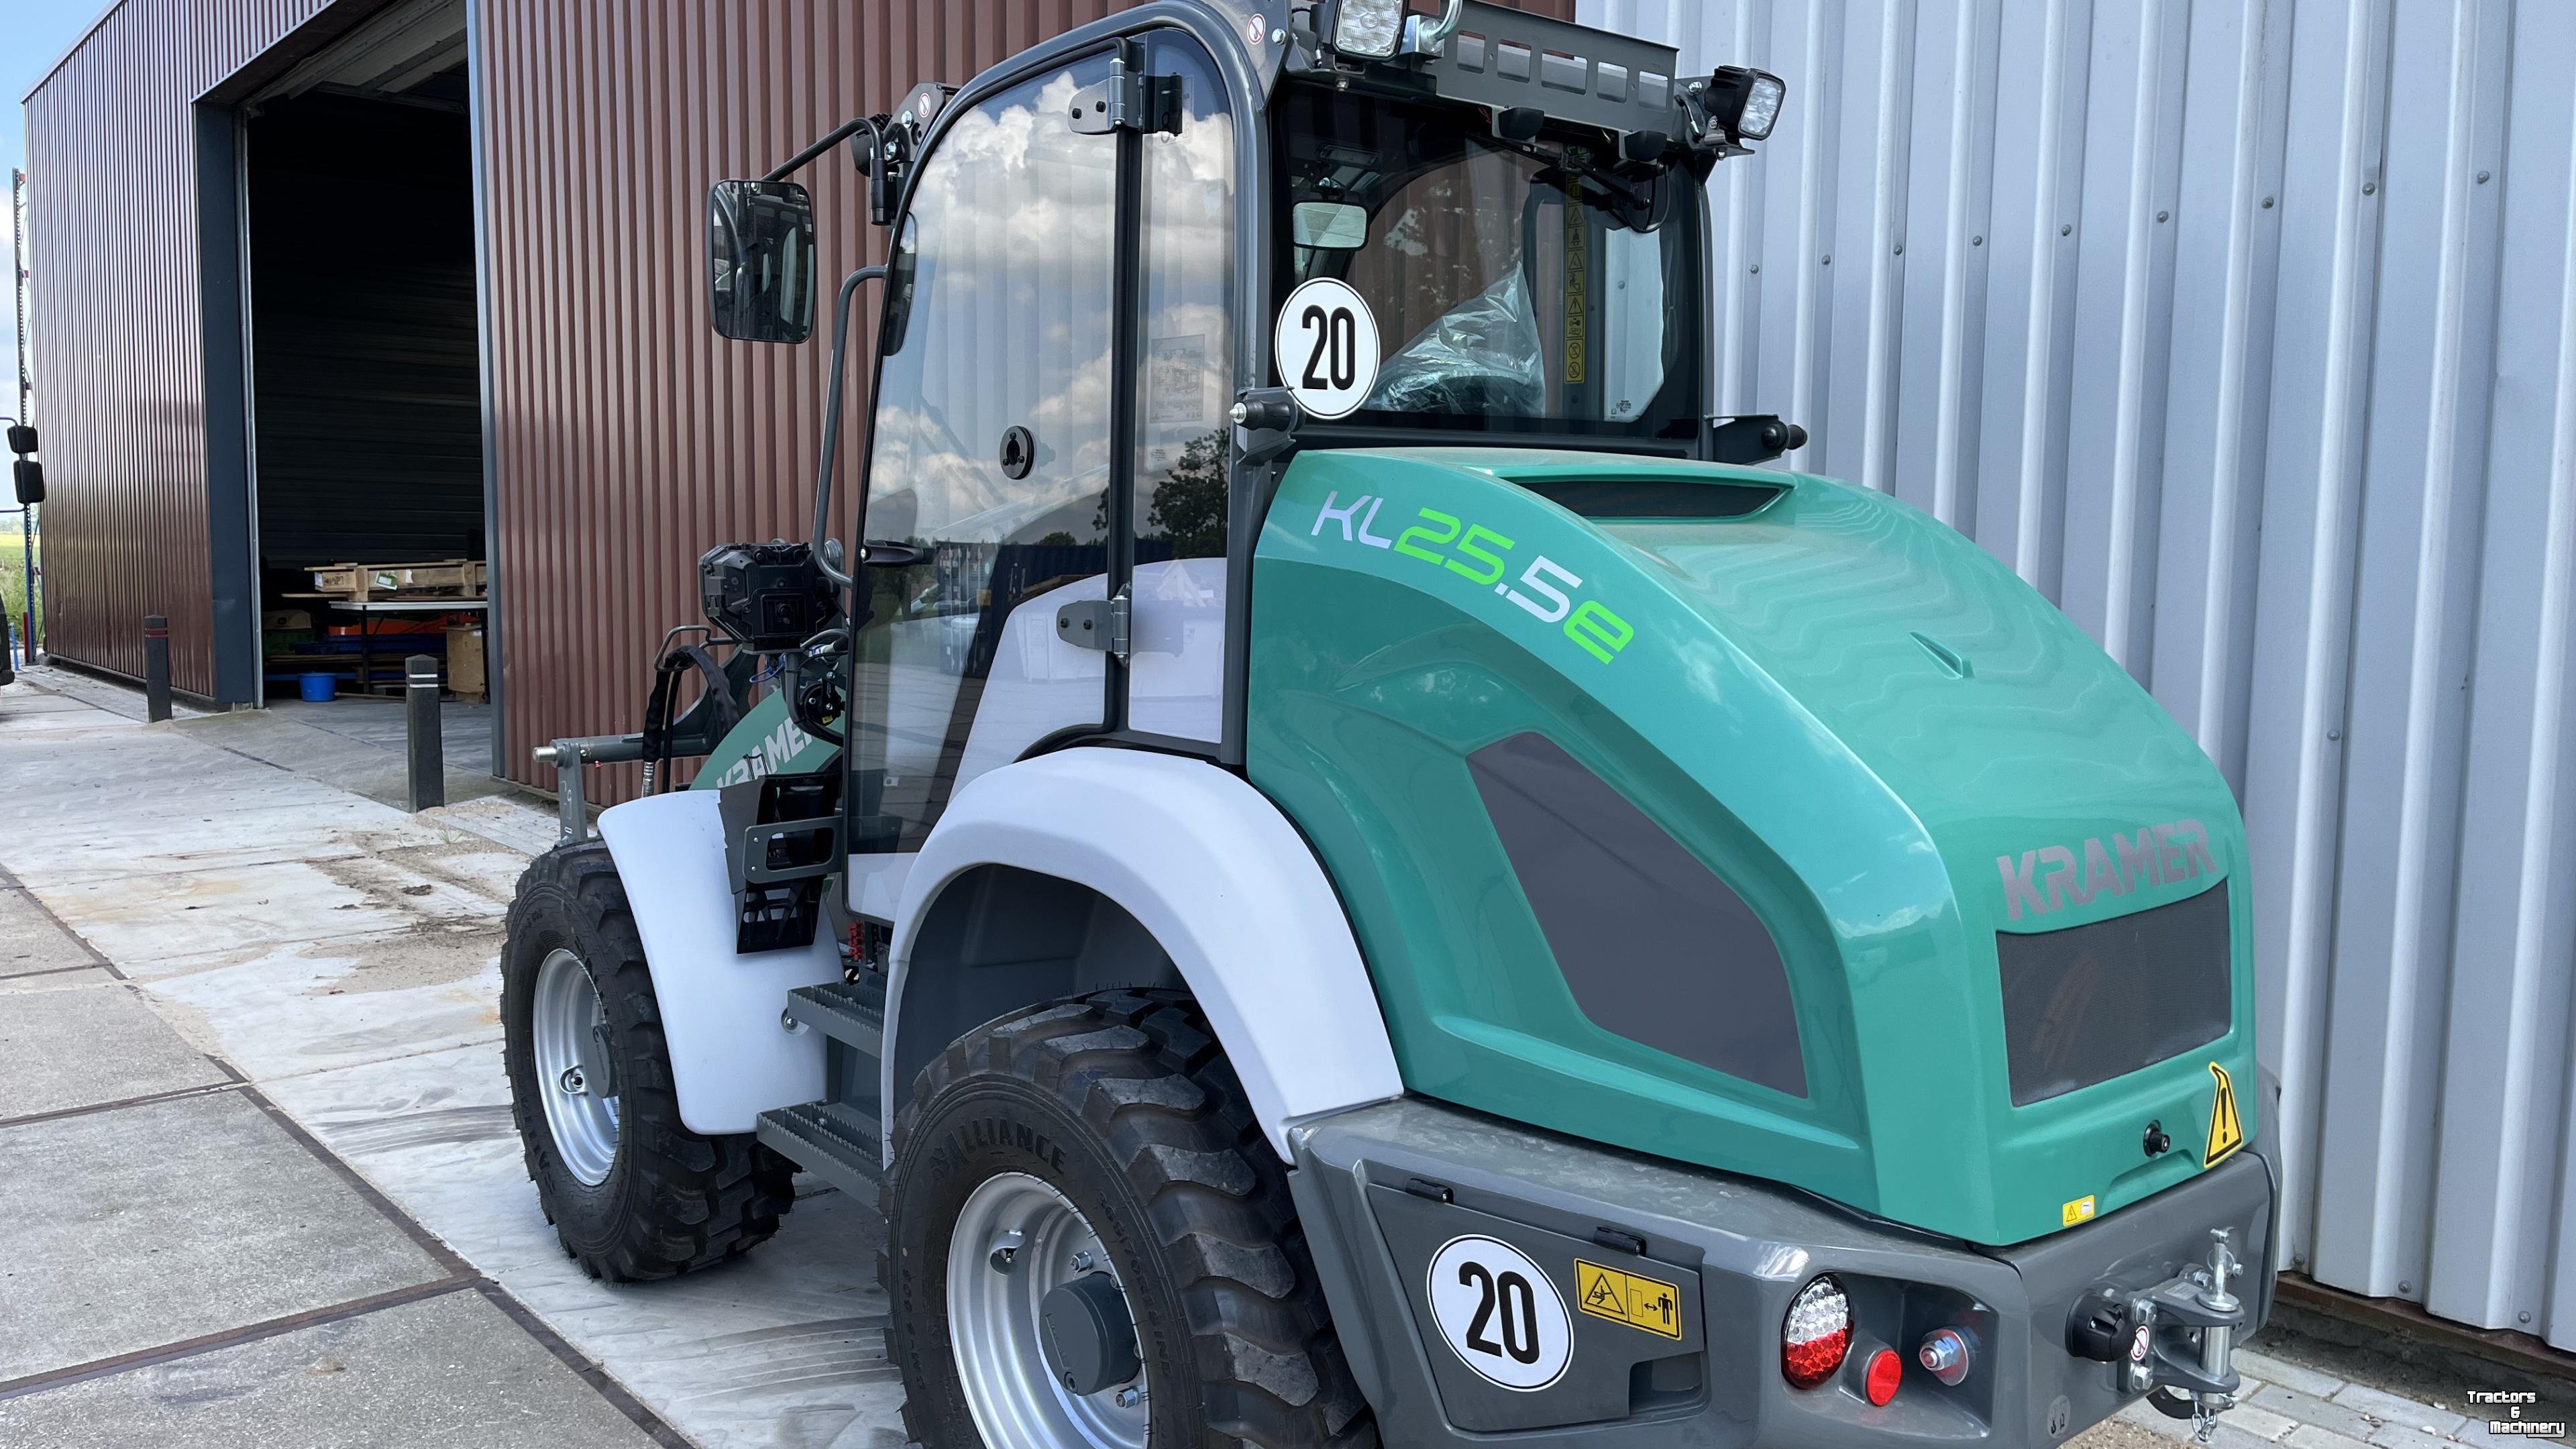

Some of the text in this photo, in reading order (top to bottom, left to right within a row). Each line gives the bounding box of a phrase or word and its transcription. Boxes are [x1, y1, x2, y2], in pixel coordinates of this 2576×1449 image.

[1301, 304, 1355, 390] 20
[716, 716, 813, 789] RAME
[1996, 818, 2218, 921] KRAMER
[945, 1116, 1067, 1175] ALLIANCE
[1458, 1260, 1540, 1364] 20
